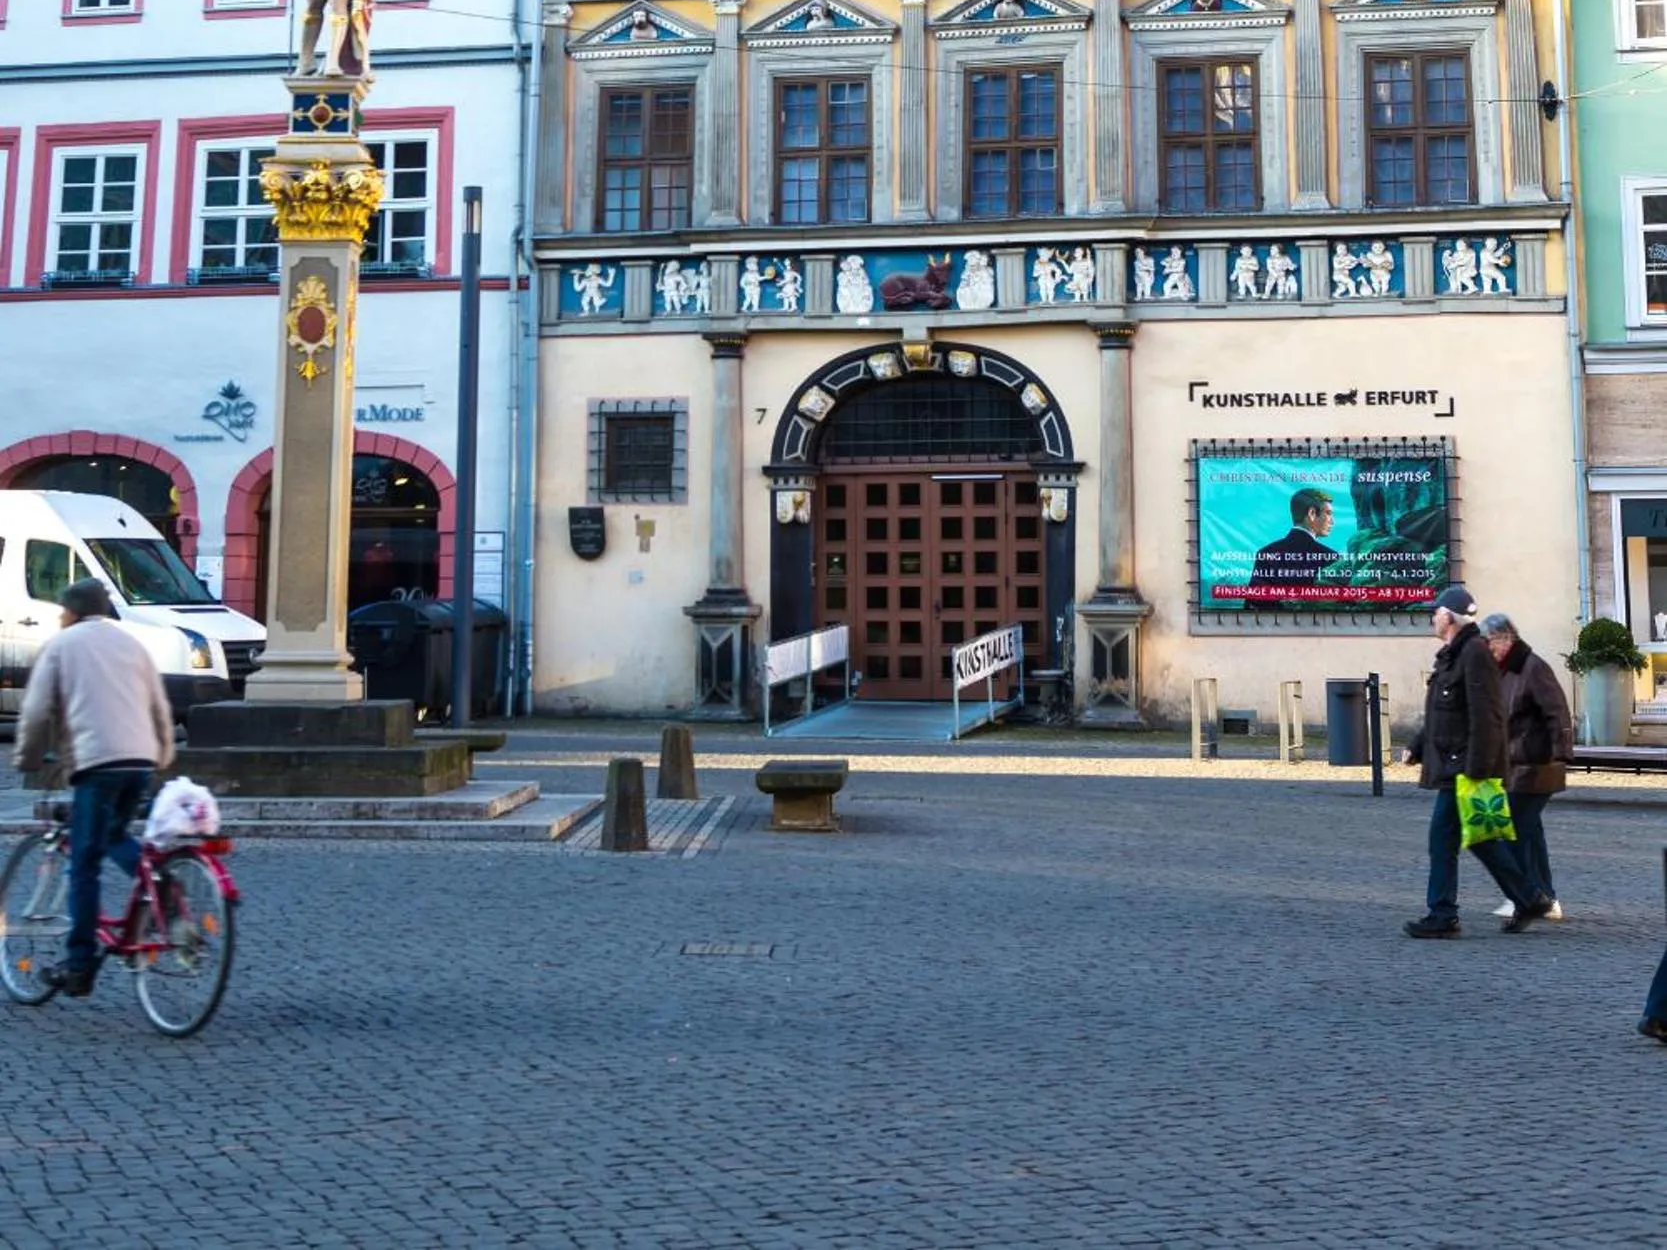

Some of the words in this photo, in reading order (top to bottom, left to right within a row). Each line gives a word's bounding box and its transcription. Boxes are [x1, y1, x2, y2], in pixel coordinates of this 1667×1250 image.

[1202, 392, 1328, 408] KUNSTHALLE
[1365, 390, 1439, 406] ERFURT
[755, 407, 768, 425] 7
[1357, 470, 1432, 487] suspense
[1284, 552, 1304, 561] DES
[1278, 569, 1315, 578] ERFURT
[1214, 585, 1267, 597] FINISSAGE
[1269, 587, 1286, 597] AM
[1301, 587, 1340, 597] JANUAR
[1378, 588, 1393, 598] AB
[1408, 588, 1433, 598] UHR
